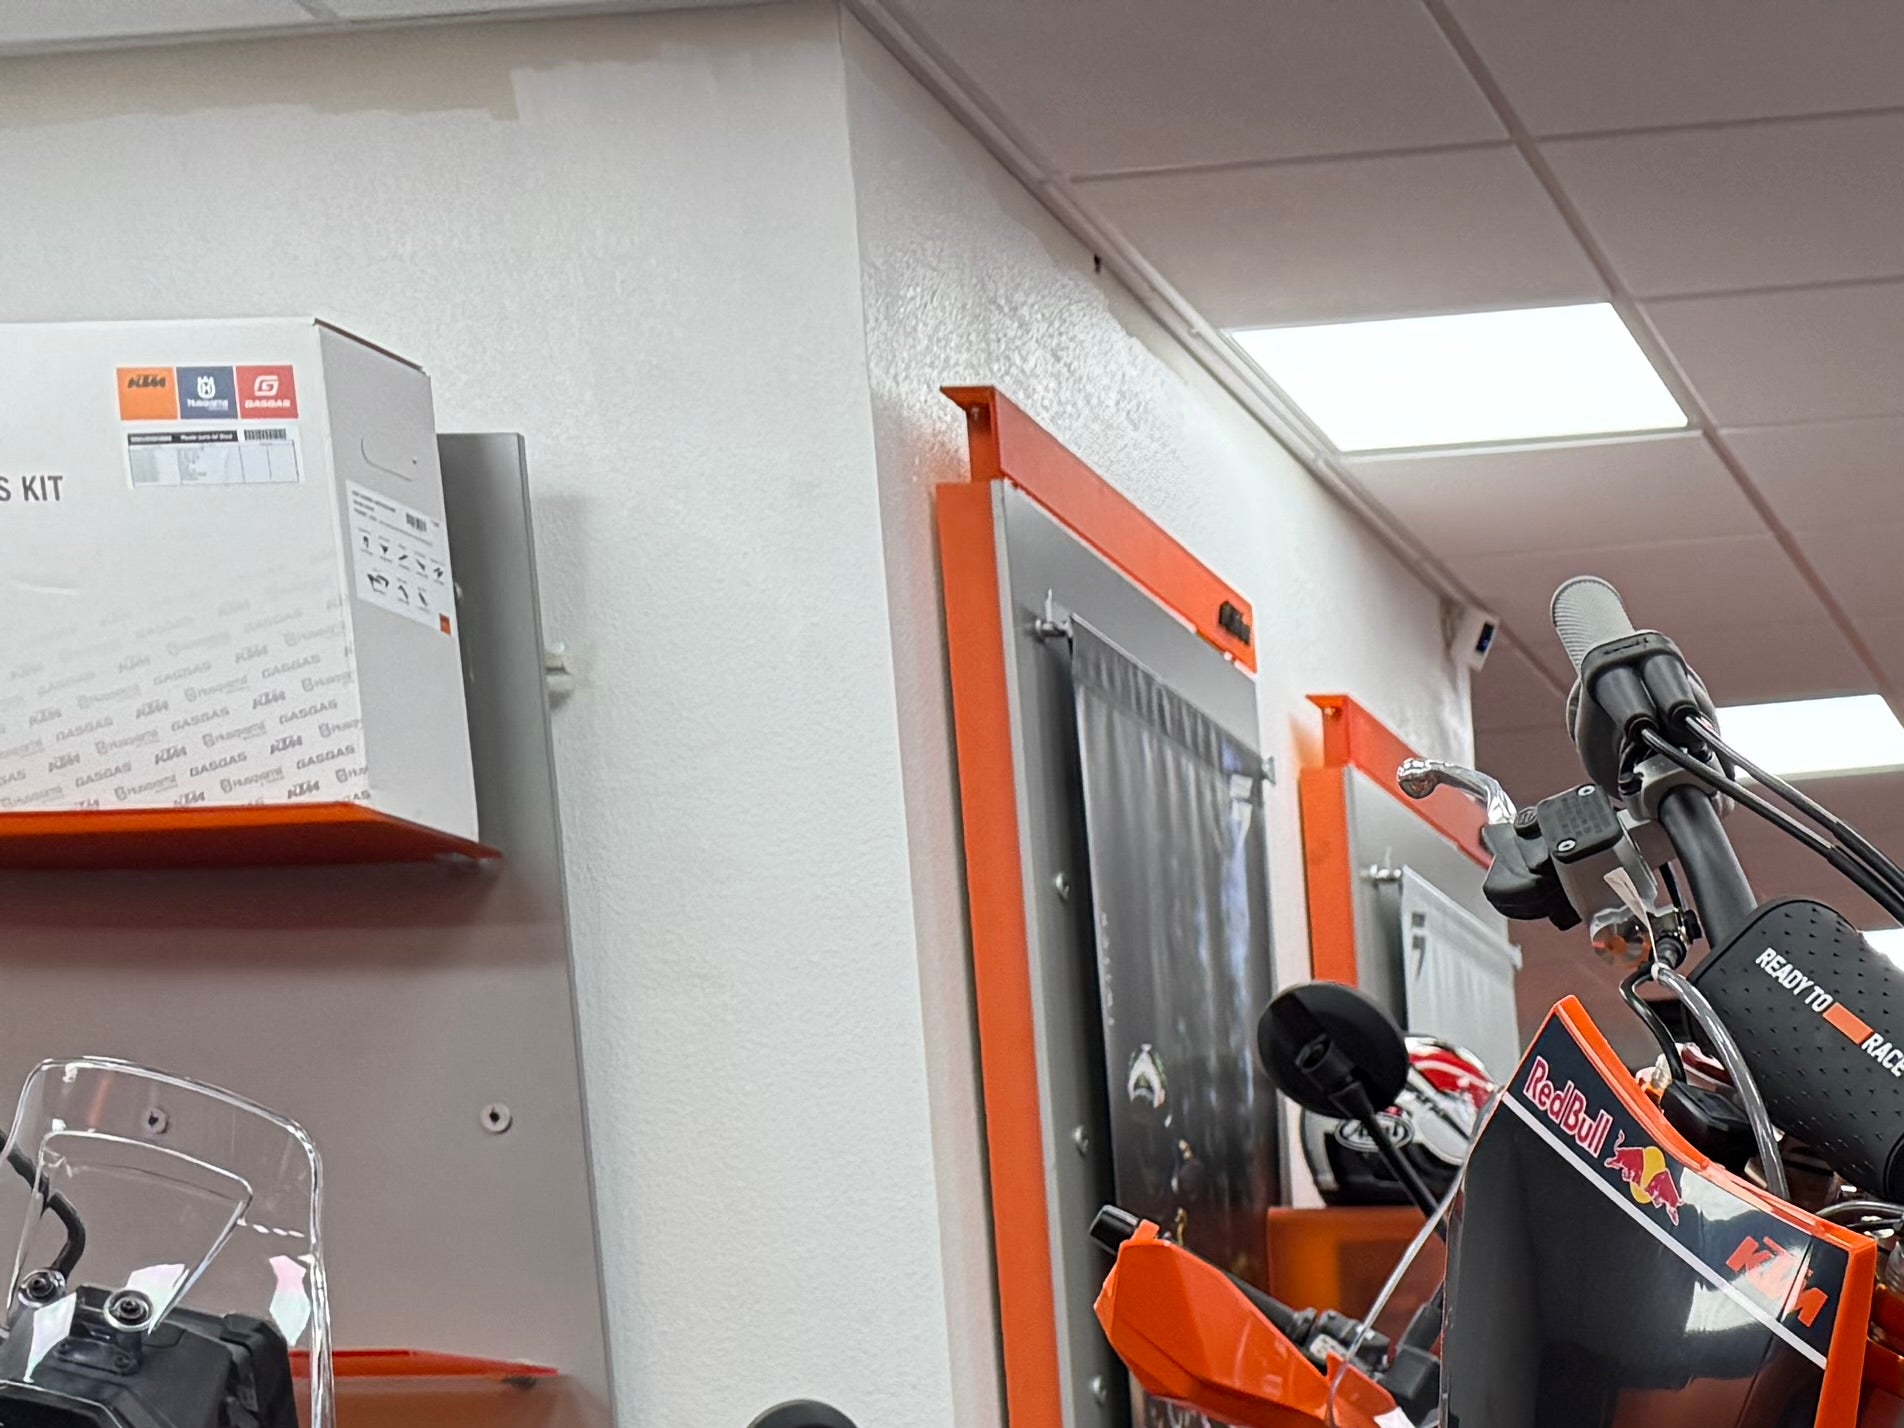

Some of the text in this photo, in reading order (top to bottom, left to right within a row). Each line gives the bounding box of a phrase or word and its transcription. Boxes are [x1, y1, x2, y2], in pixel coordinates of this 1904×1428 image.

[21, 475, 63, 501] KIT
[1755, 946, 1833, 1012] READY TO
[1524, 1056, 1613, 1158] Red Bull
